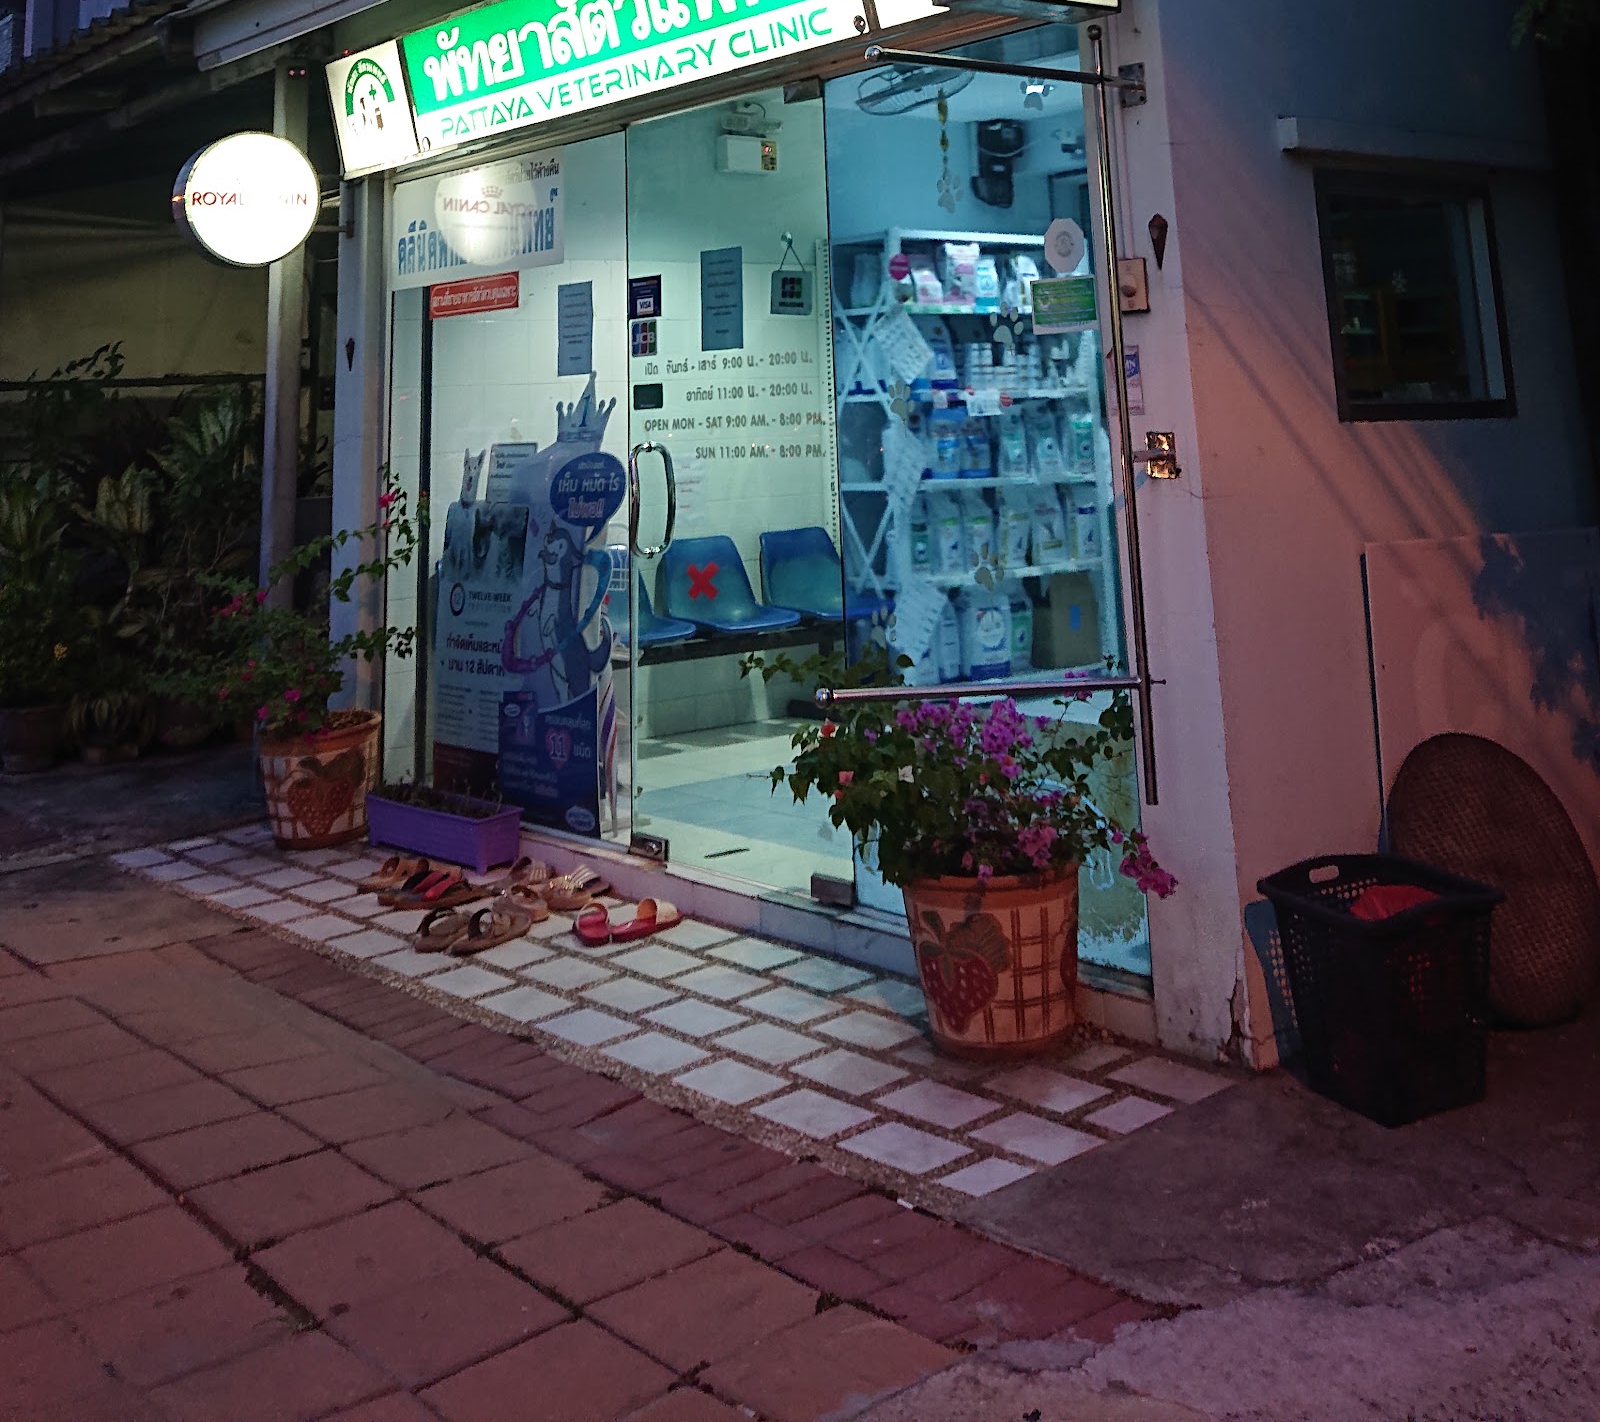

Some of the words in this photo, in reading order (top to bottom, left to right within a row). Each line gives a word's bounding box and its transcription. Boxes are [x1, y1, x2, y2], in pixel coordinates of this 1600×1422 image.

[440, 95, 535, 139] PATTAYA
[536, 38, 717, 110] VETERINARY
[727, 6, 833, 59] CLINIC
[191, 190, 245, 206] ROYAL
[639, 300, 652, 310] VISA
[632, 331, 655, 344] JCB
[644, 362, 659, 375] เปิด
[666, 357, 689, 374] จันทร์
[698, 354, 717, 371] เสาร์
[722, 356, 743, 370] 9:00
[768, 352, 797, 366] 20:00
[686, 385, 713, 402] อาทิตย์
[717, 386, 743, 400] 11:00
[769, 382, 798, 397] 20:00
[644, 418, 669, 432] OPEN
[672, 416, 695, 430] MON
[705, 415, 722, 429] SAT
[725, 414, 747, 428] 9:00
[750, 414, 770, 427] AM.
[779, 412, 801, 426] 8:00
[695, 446, 716, 459] SUN
[719, 445, 746, 458] 11:00
[779, 443, 801, 457] 8:00
[558, 471, 578, 493] เห็บ
[581, 472, 606, 492] หมัด
[493, 591, 512, 603] WEEK
[465, 659, 475, 673] 12
[549, 732, 568, 761] 11
